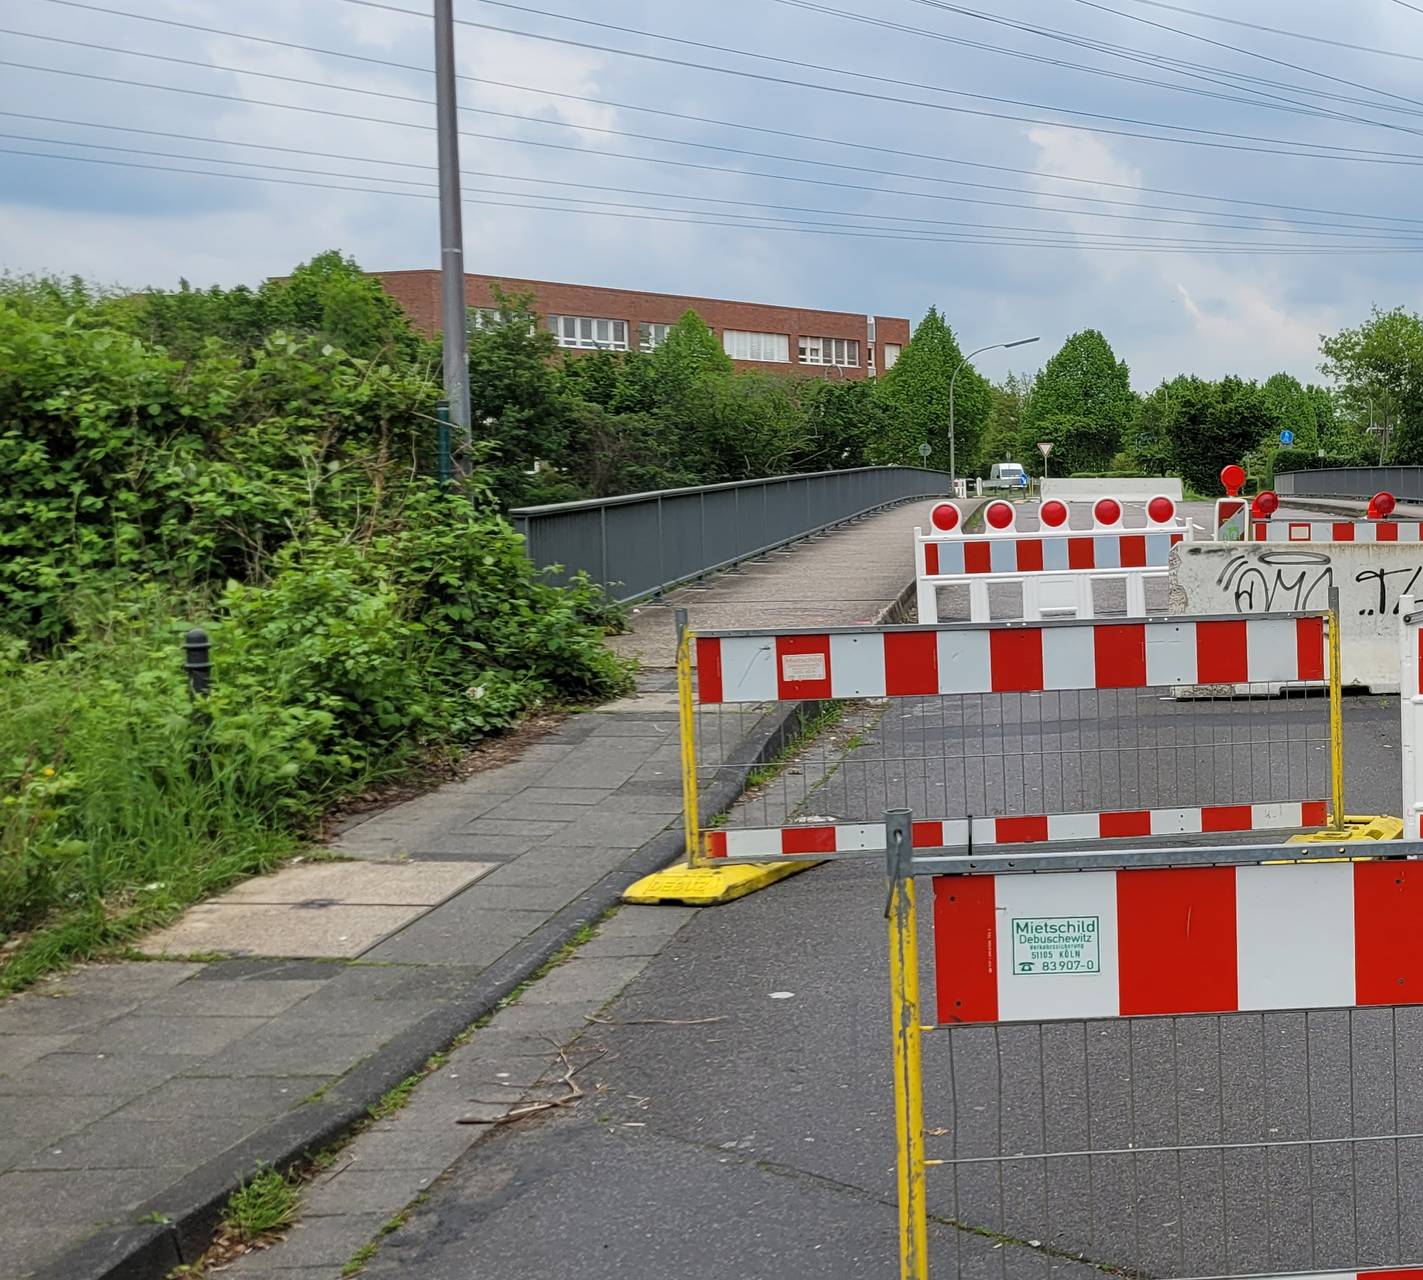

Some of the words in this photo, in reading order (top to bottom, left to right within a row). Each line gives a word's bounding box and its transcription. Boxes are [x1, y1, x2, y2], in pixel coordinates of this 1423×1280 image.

[1016, 920, 1095, 934] Mietschild
[1019, 933, 1092, 944] Debuschewitz
[1031, 951, 1053, 959] 51105
[1059, 949, 1081, 959] KÖLN
